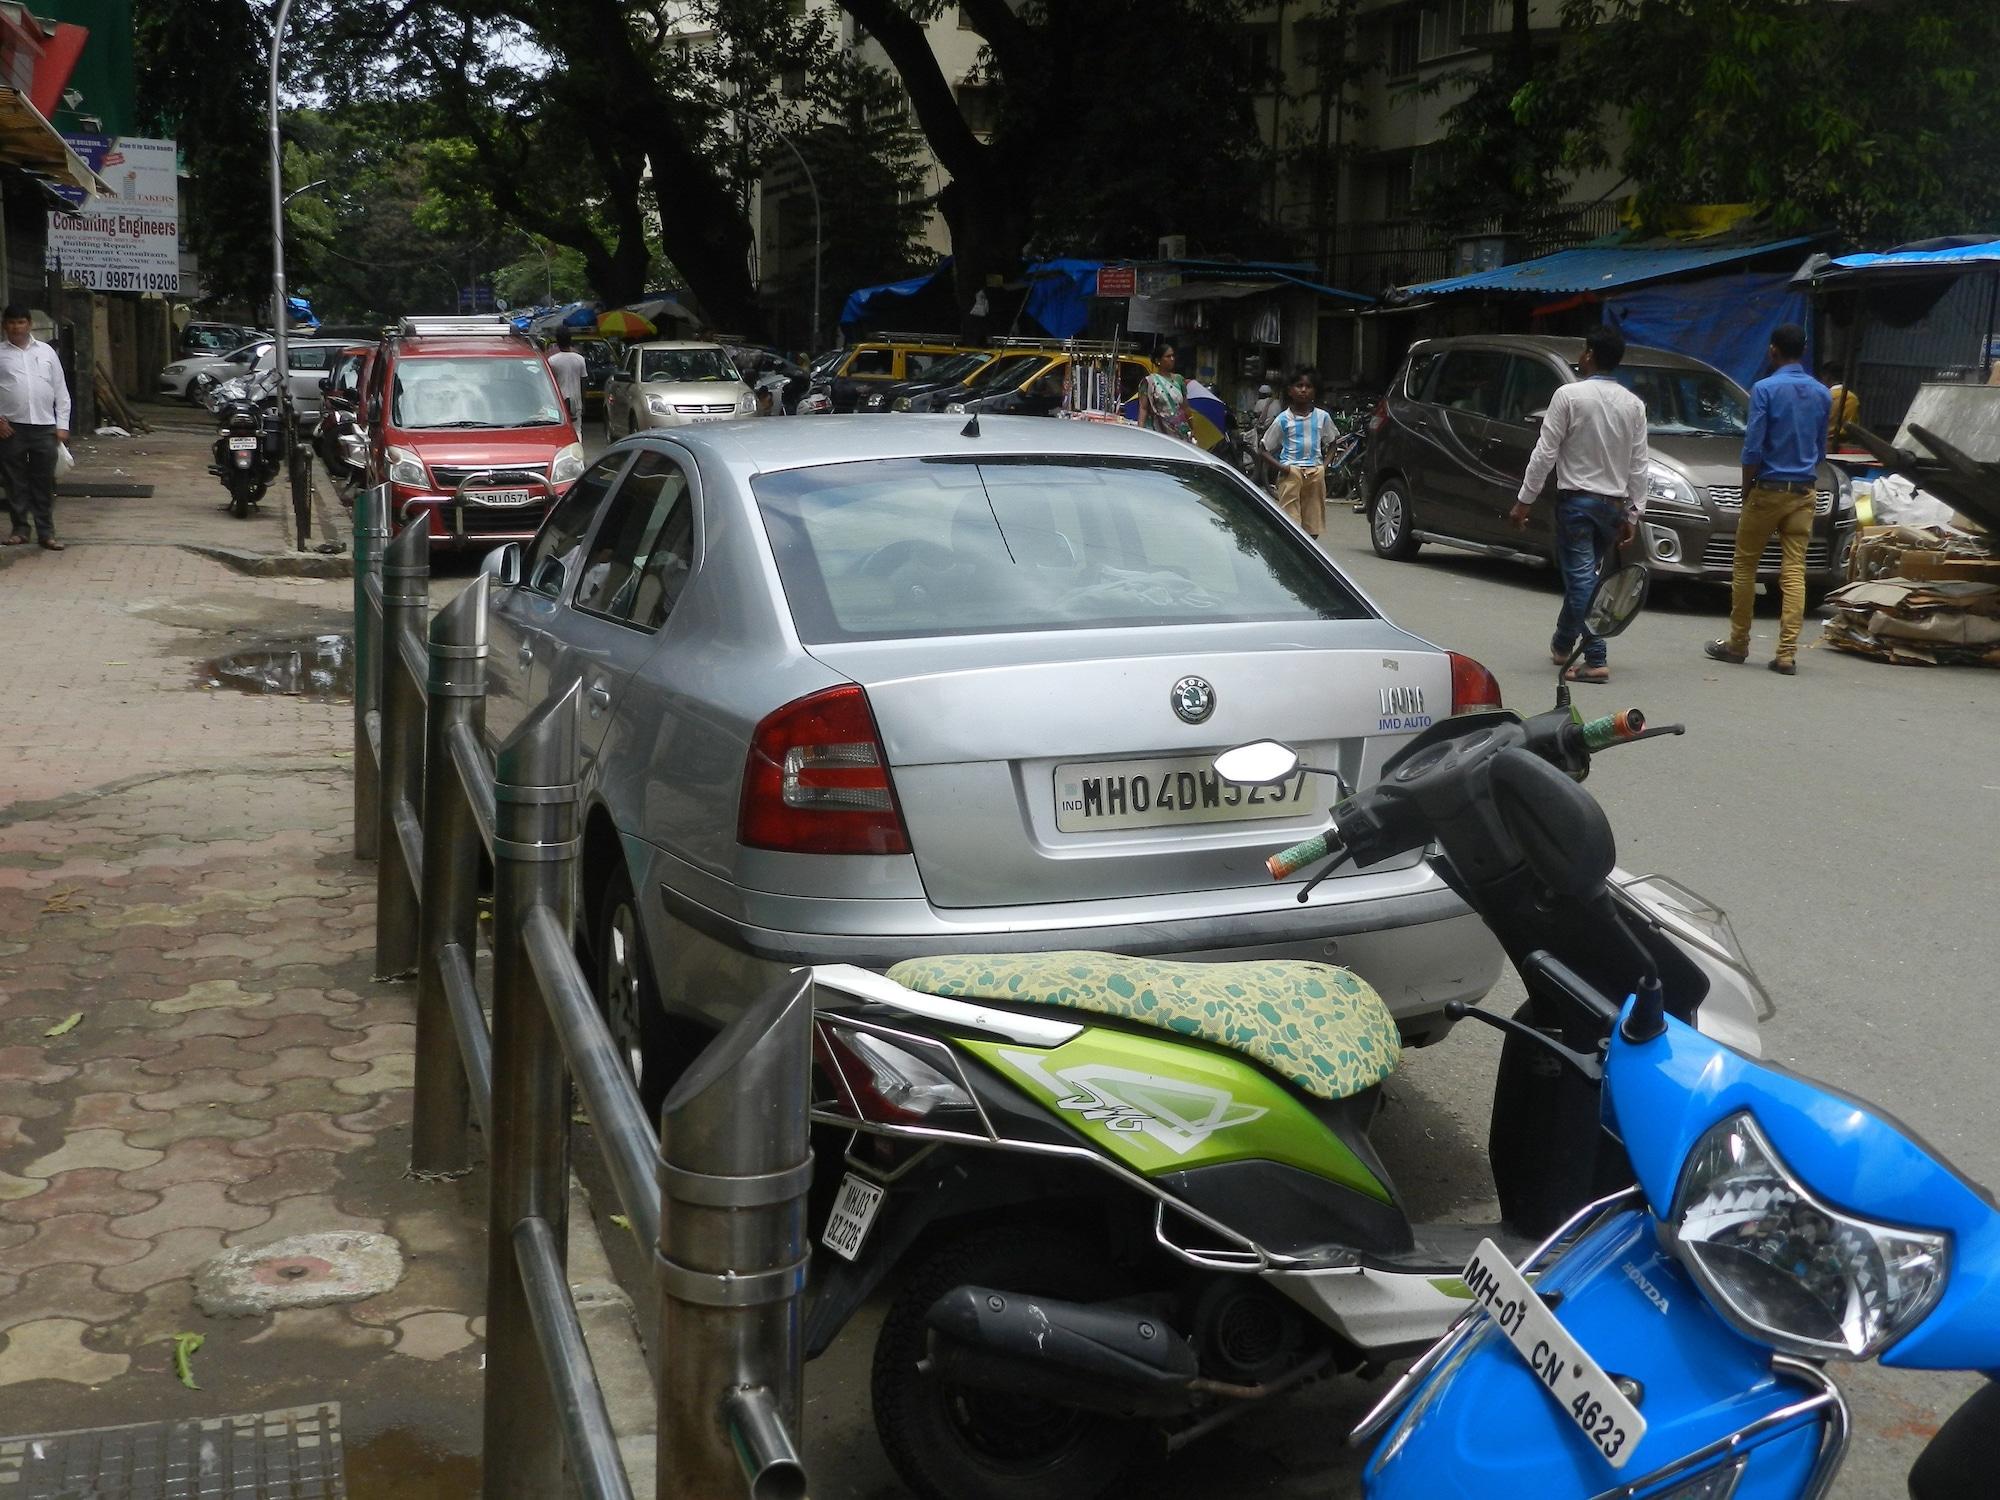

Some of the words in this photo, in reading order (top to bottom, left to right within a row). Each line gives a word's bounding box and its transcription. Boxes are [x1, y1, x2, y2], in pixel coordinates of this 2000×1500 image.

[53, 211, 116, 237] Consulting
[119, 215, 176, 238] Engineers
[63, 240, 101, 248] Building
[106, 270, 178, 290] 9987119208
[1378, 718, 1401, 730] JMD
[1403, 716, 1432, 729] AUTO
[1062, 800, 1083, 812] IND
[1622, 1261, 1669, 1315] HONDA
[1463, 1257, 1526, 1336] MH-01
[1531, 1340, 1564, 1387] CN
[1572, 1390, 1625, 1458] 4623
